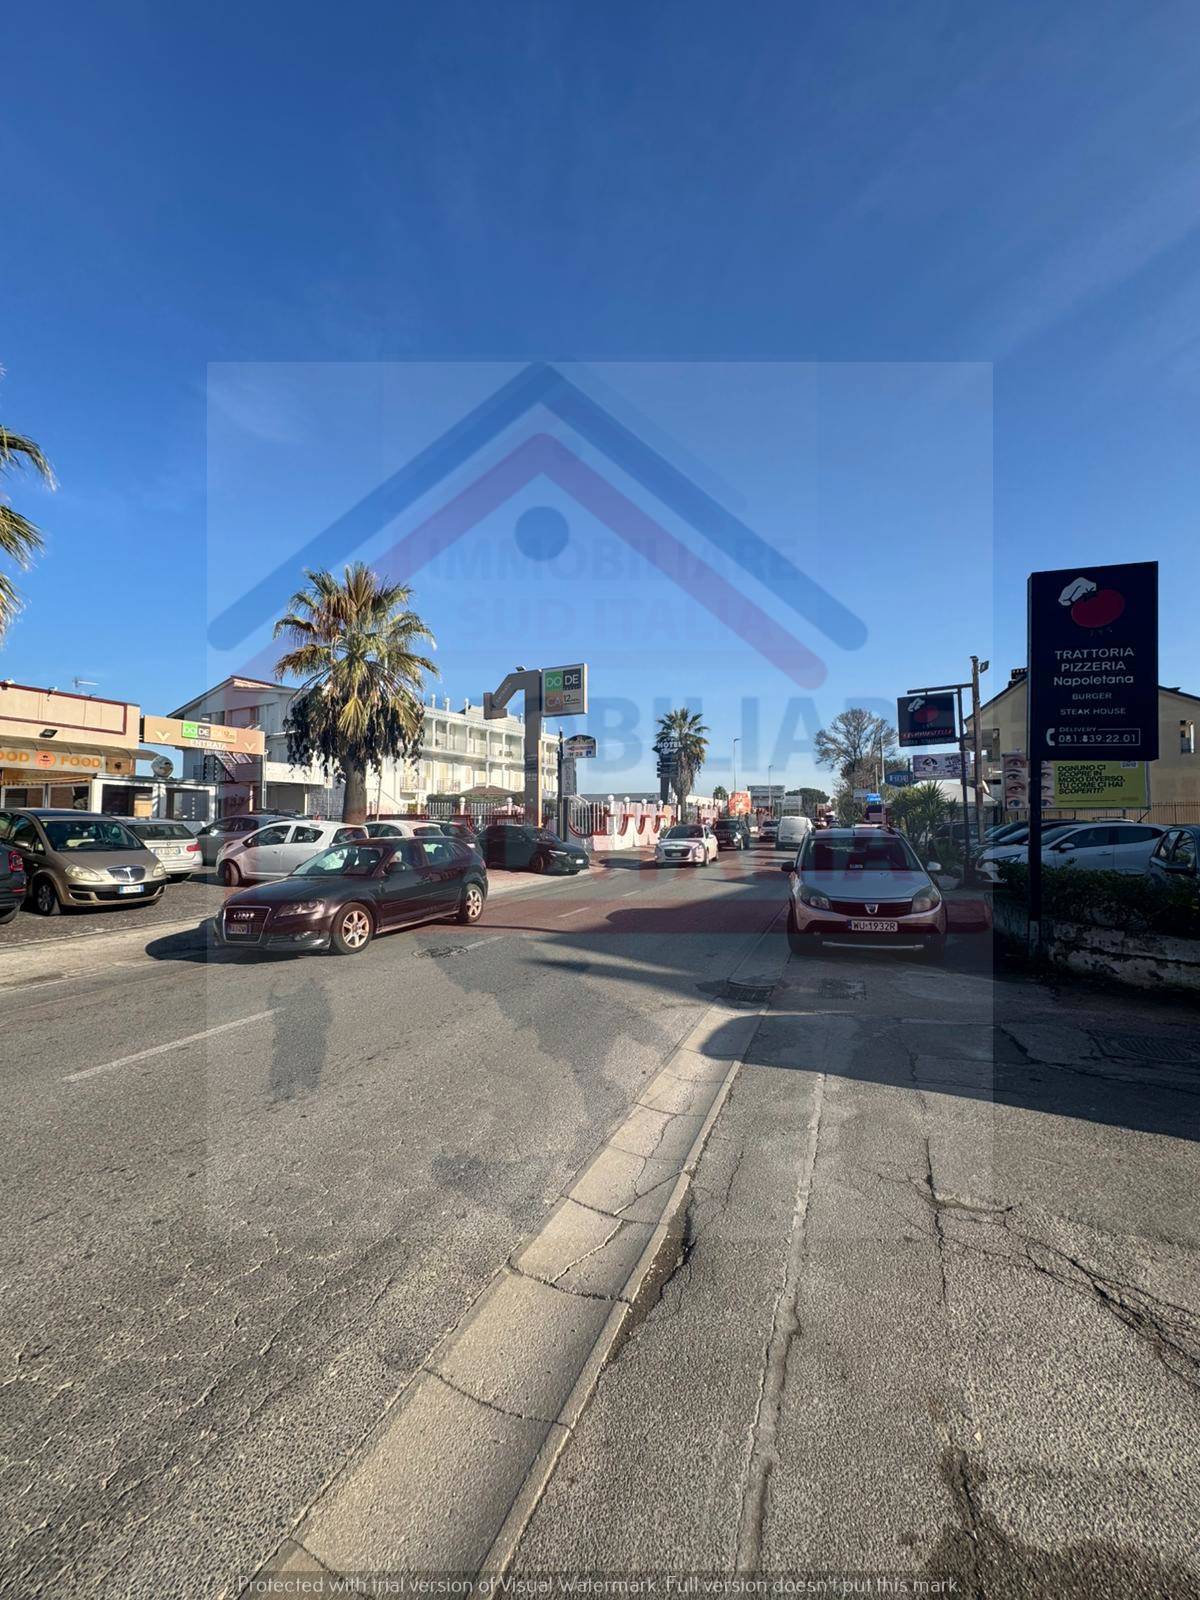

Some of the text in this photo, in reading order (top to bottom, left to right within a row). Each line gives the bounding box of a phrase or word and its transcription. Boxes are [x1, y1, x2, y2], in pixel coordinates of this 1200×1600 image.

[1054, 647, 1135, 660] TRATTORIA
[1061, 661, 1127, 673] PIZZERIA
[1053, 675, 1135, 687] Napoletana
[1072, 692, 1113, 700] BURGER
[1060, 707, 1127, 716] STEAK HOUSE
[1058, 734, 1136, 743] 081.839.22.01
[657, 741, 684, 749] HOTEL
[61, 755, 101, 768] FOOD
